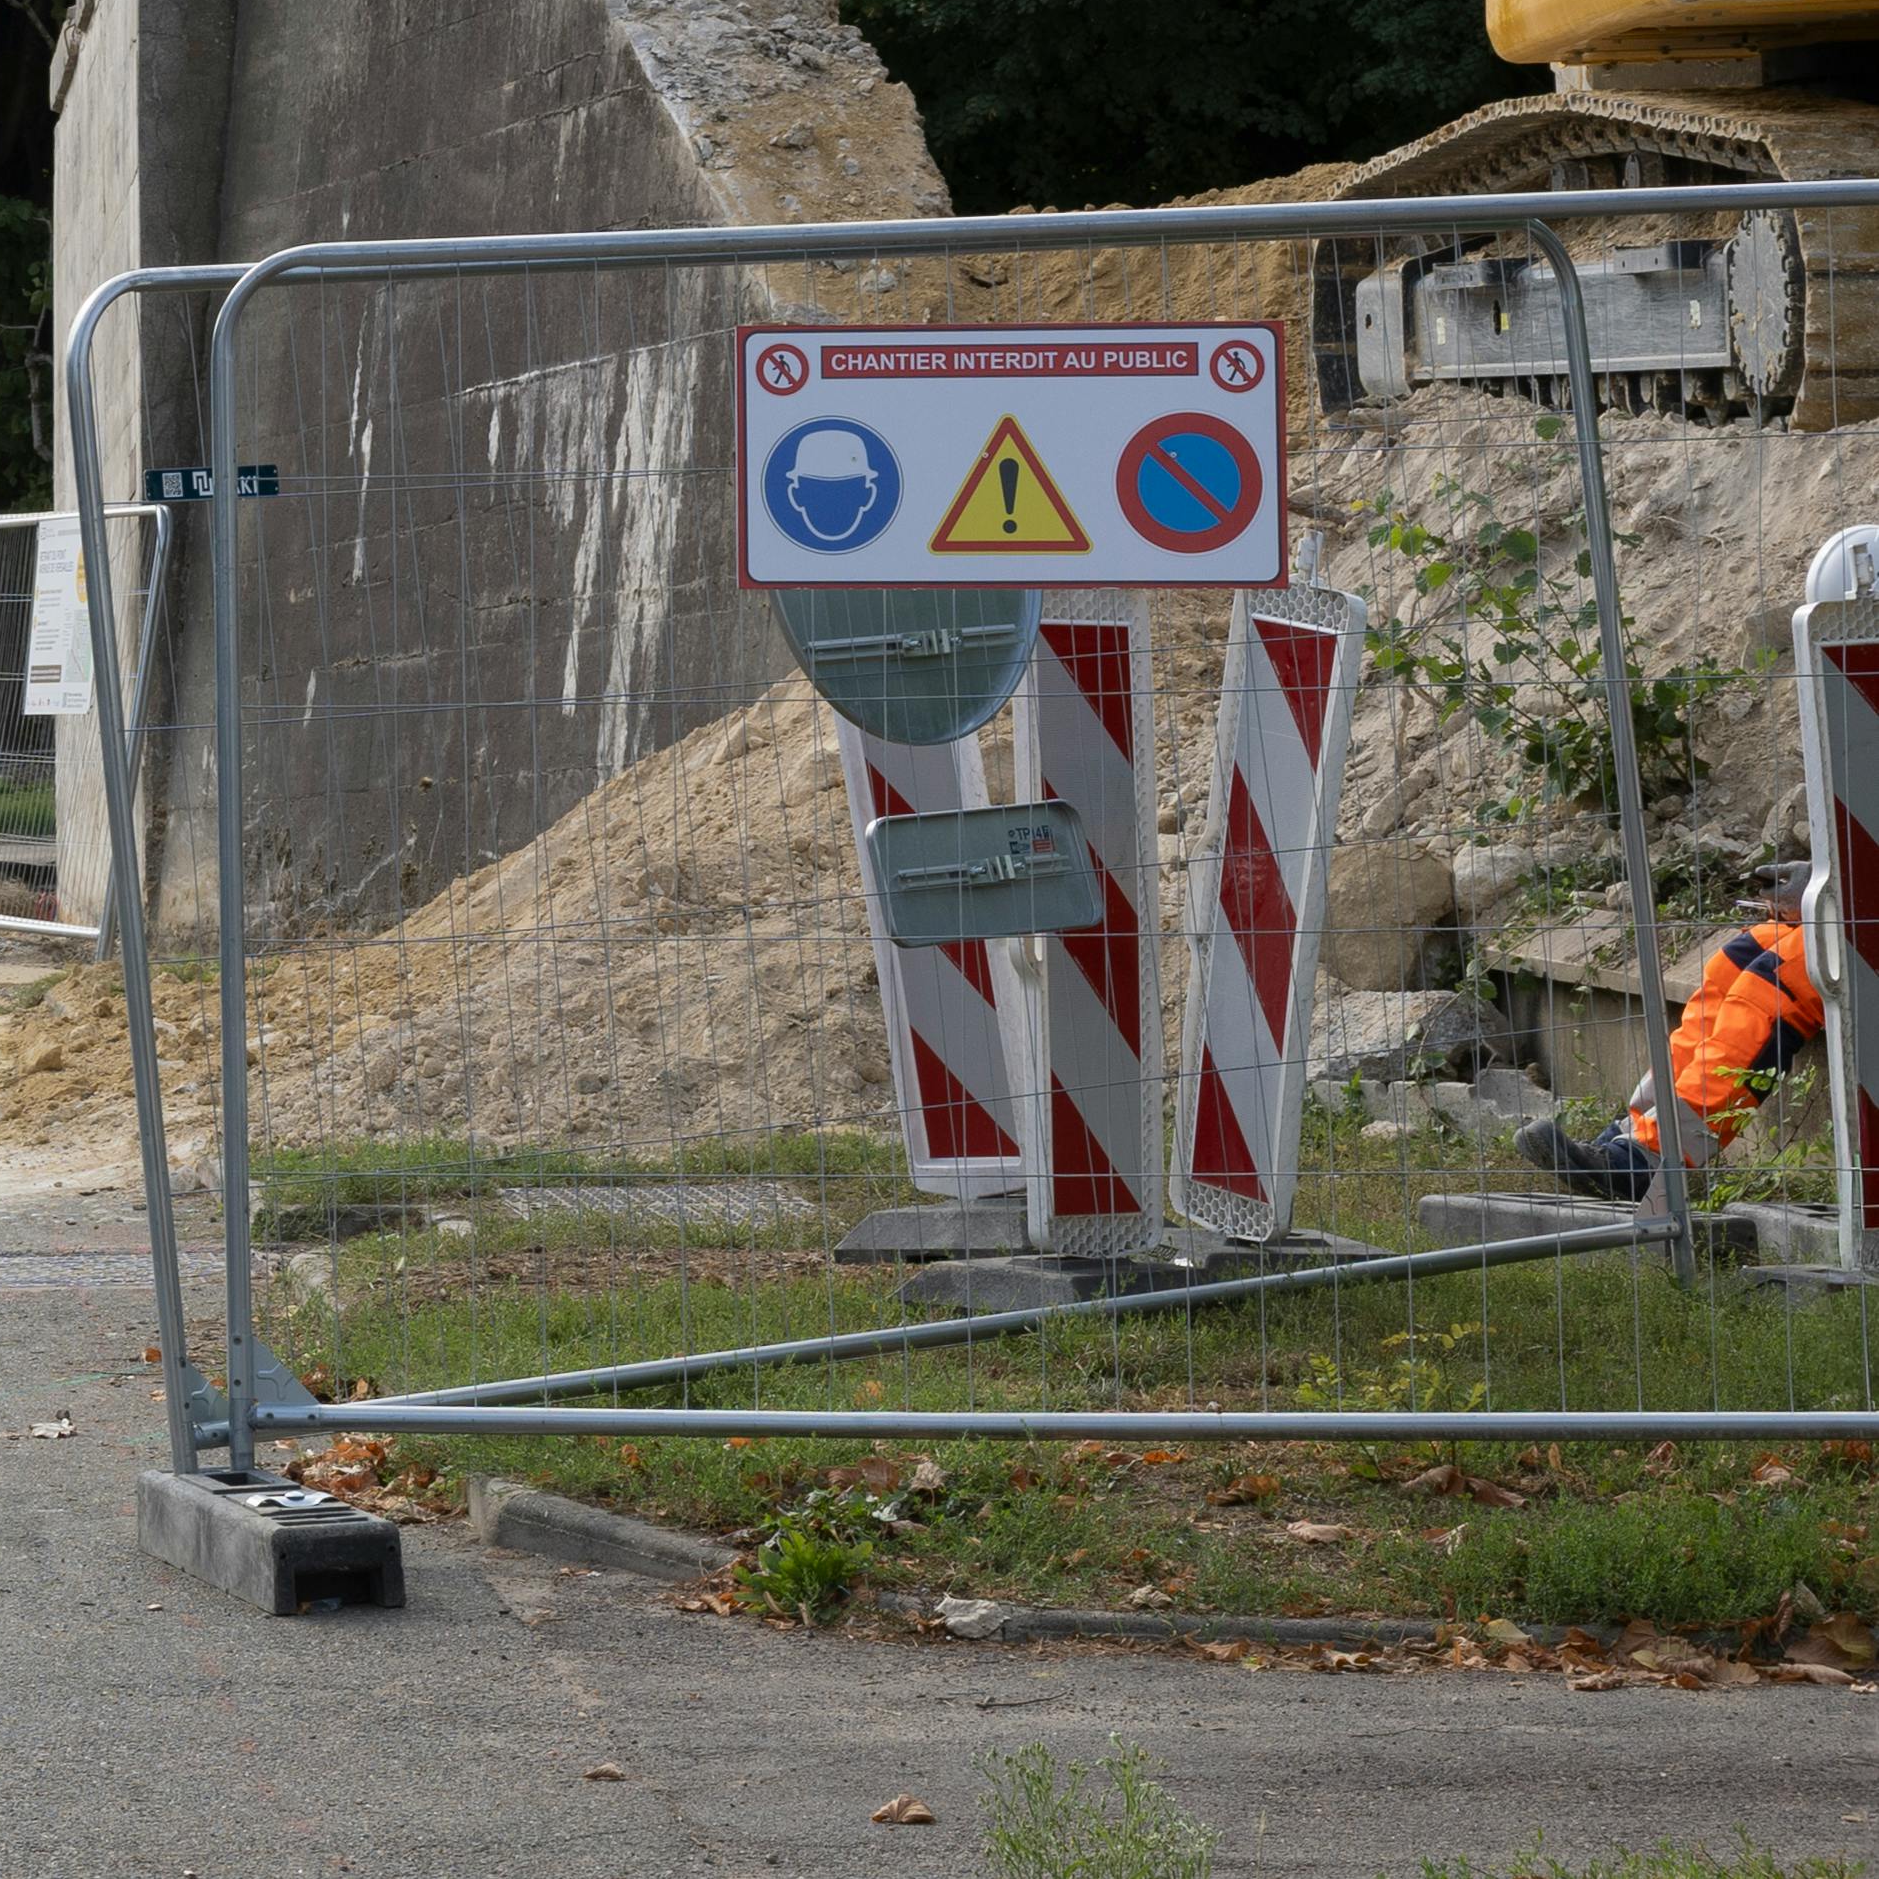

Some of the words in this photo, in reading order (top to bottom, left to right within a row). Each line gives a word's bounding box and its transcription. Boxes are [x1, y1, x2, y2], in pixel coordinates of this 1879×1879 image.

[831, 353, 947, 371] CHANTIER
[954, 352, 1058, 370] INTERDIT
[1063, 351, 1097, 369] AU
[1103, 350, 1188, 368] PUBLIC
